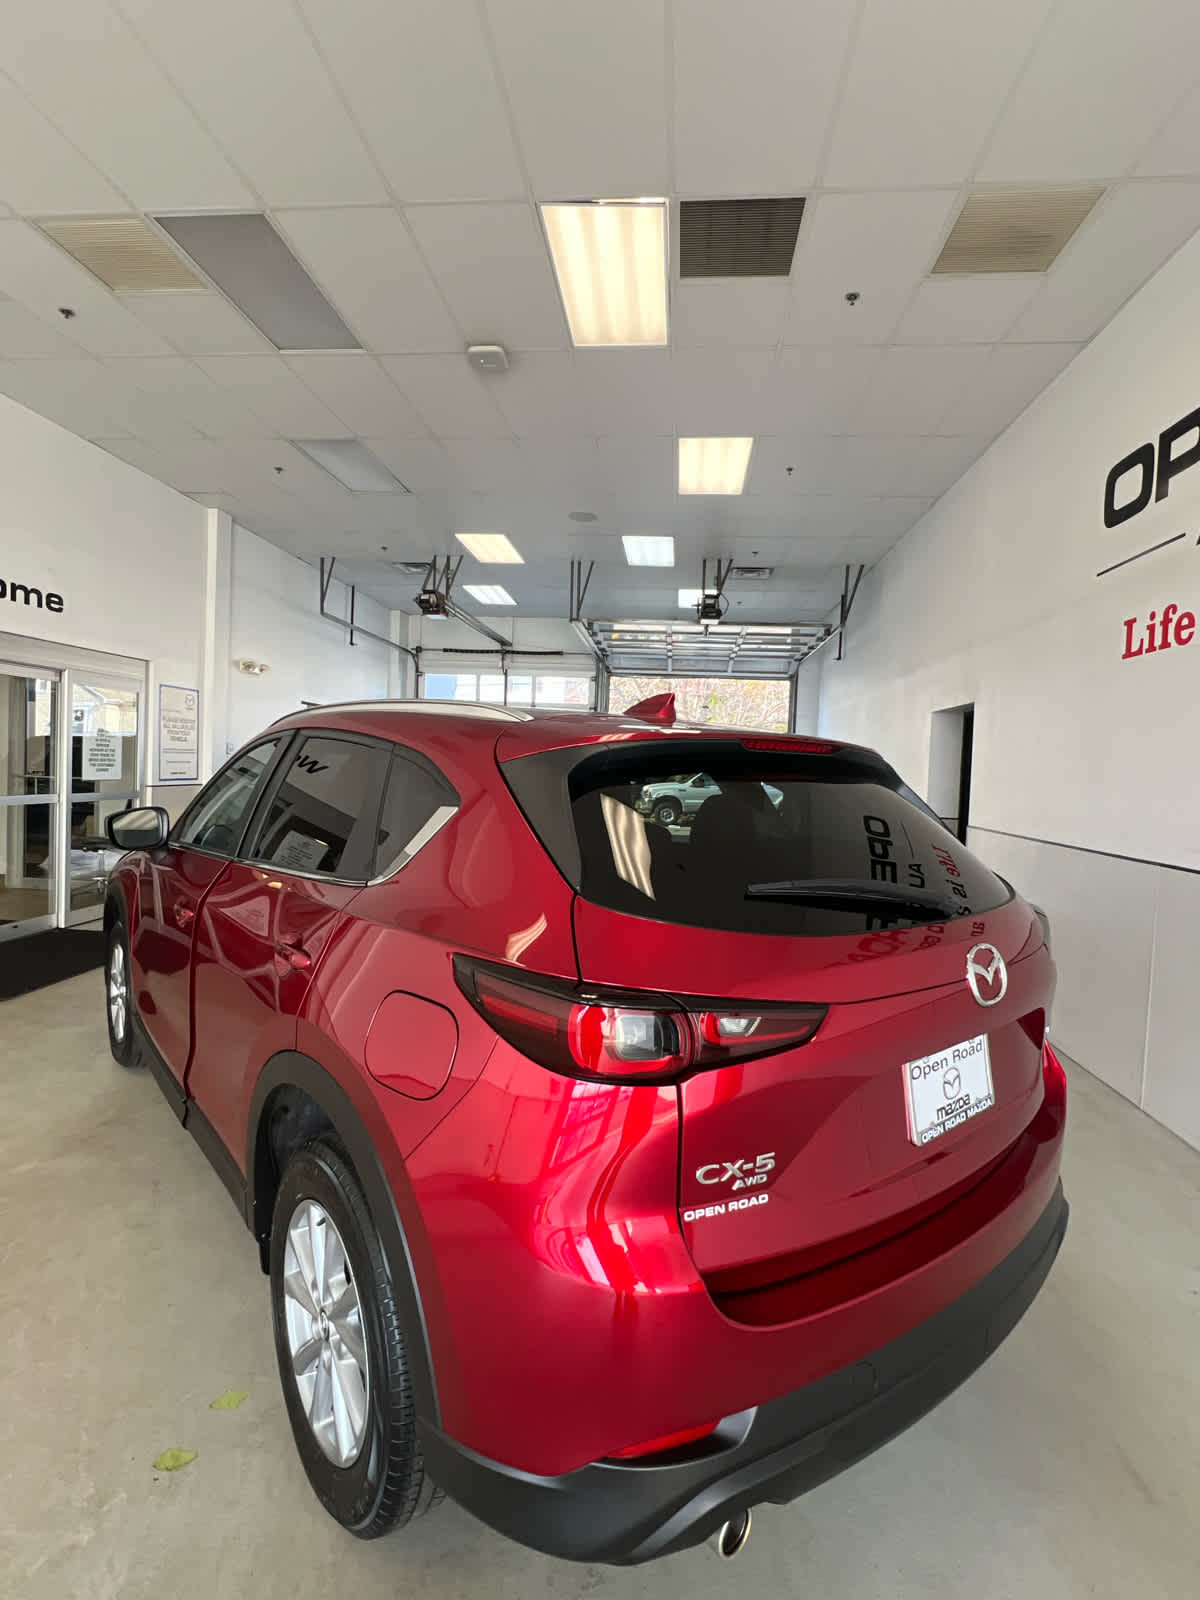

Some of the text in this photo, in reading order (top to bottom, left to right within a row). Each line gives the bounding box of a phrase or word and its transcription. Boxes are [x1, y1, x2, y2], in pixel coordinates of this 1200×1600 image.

[1121, 603, 1196, 660] Life
[911, 1038, 983, 1080] Open Road
[921, 1123, 945, 1144] OPEN
[944, 1112, 967, 1131] ROAD
[695, 1151, 776, 1185] CX-5
[731, 1173, 768, 1191] AWD
[683, 1193, 769, 1222] OPEN ROAD
